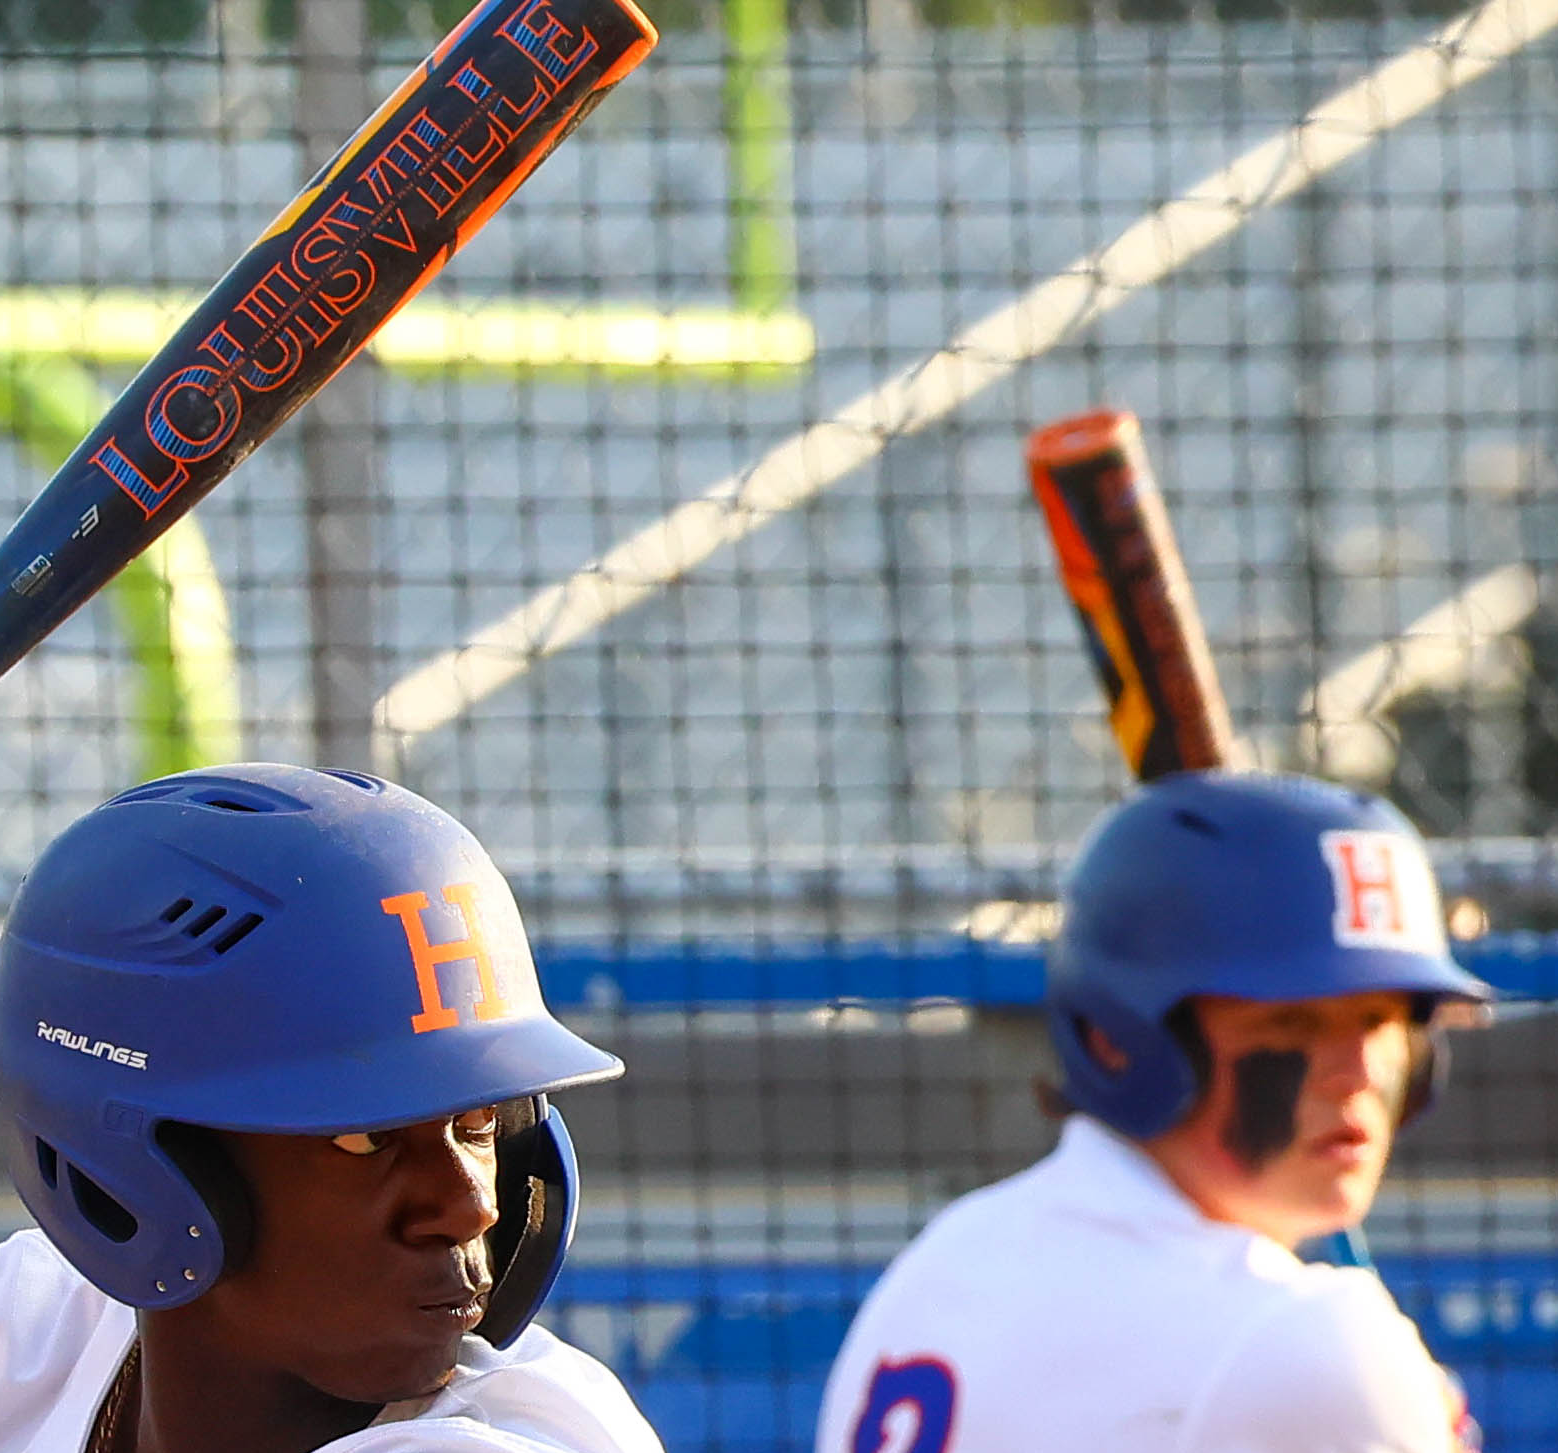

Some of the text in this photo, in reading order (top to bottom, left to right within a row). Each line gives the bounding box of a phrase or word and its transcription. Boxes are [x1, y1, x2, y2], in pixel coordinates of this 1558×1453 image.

[88, 0, 601, 521] LOUISVILLE
[1327, 834, 1421, 944] H
[380, 883, 511, 1034] H
[37, 1021, 148, 1070] RAWLINGS
